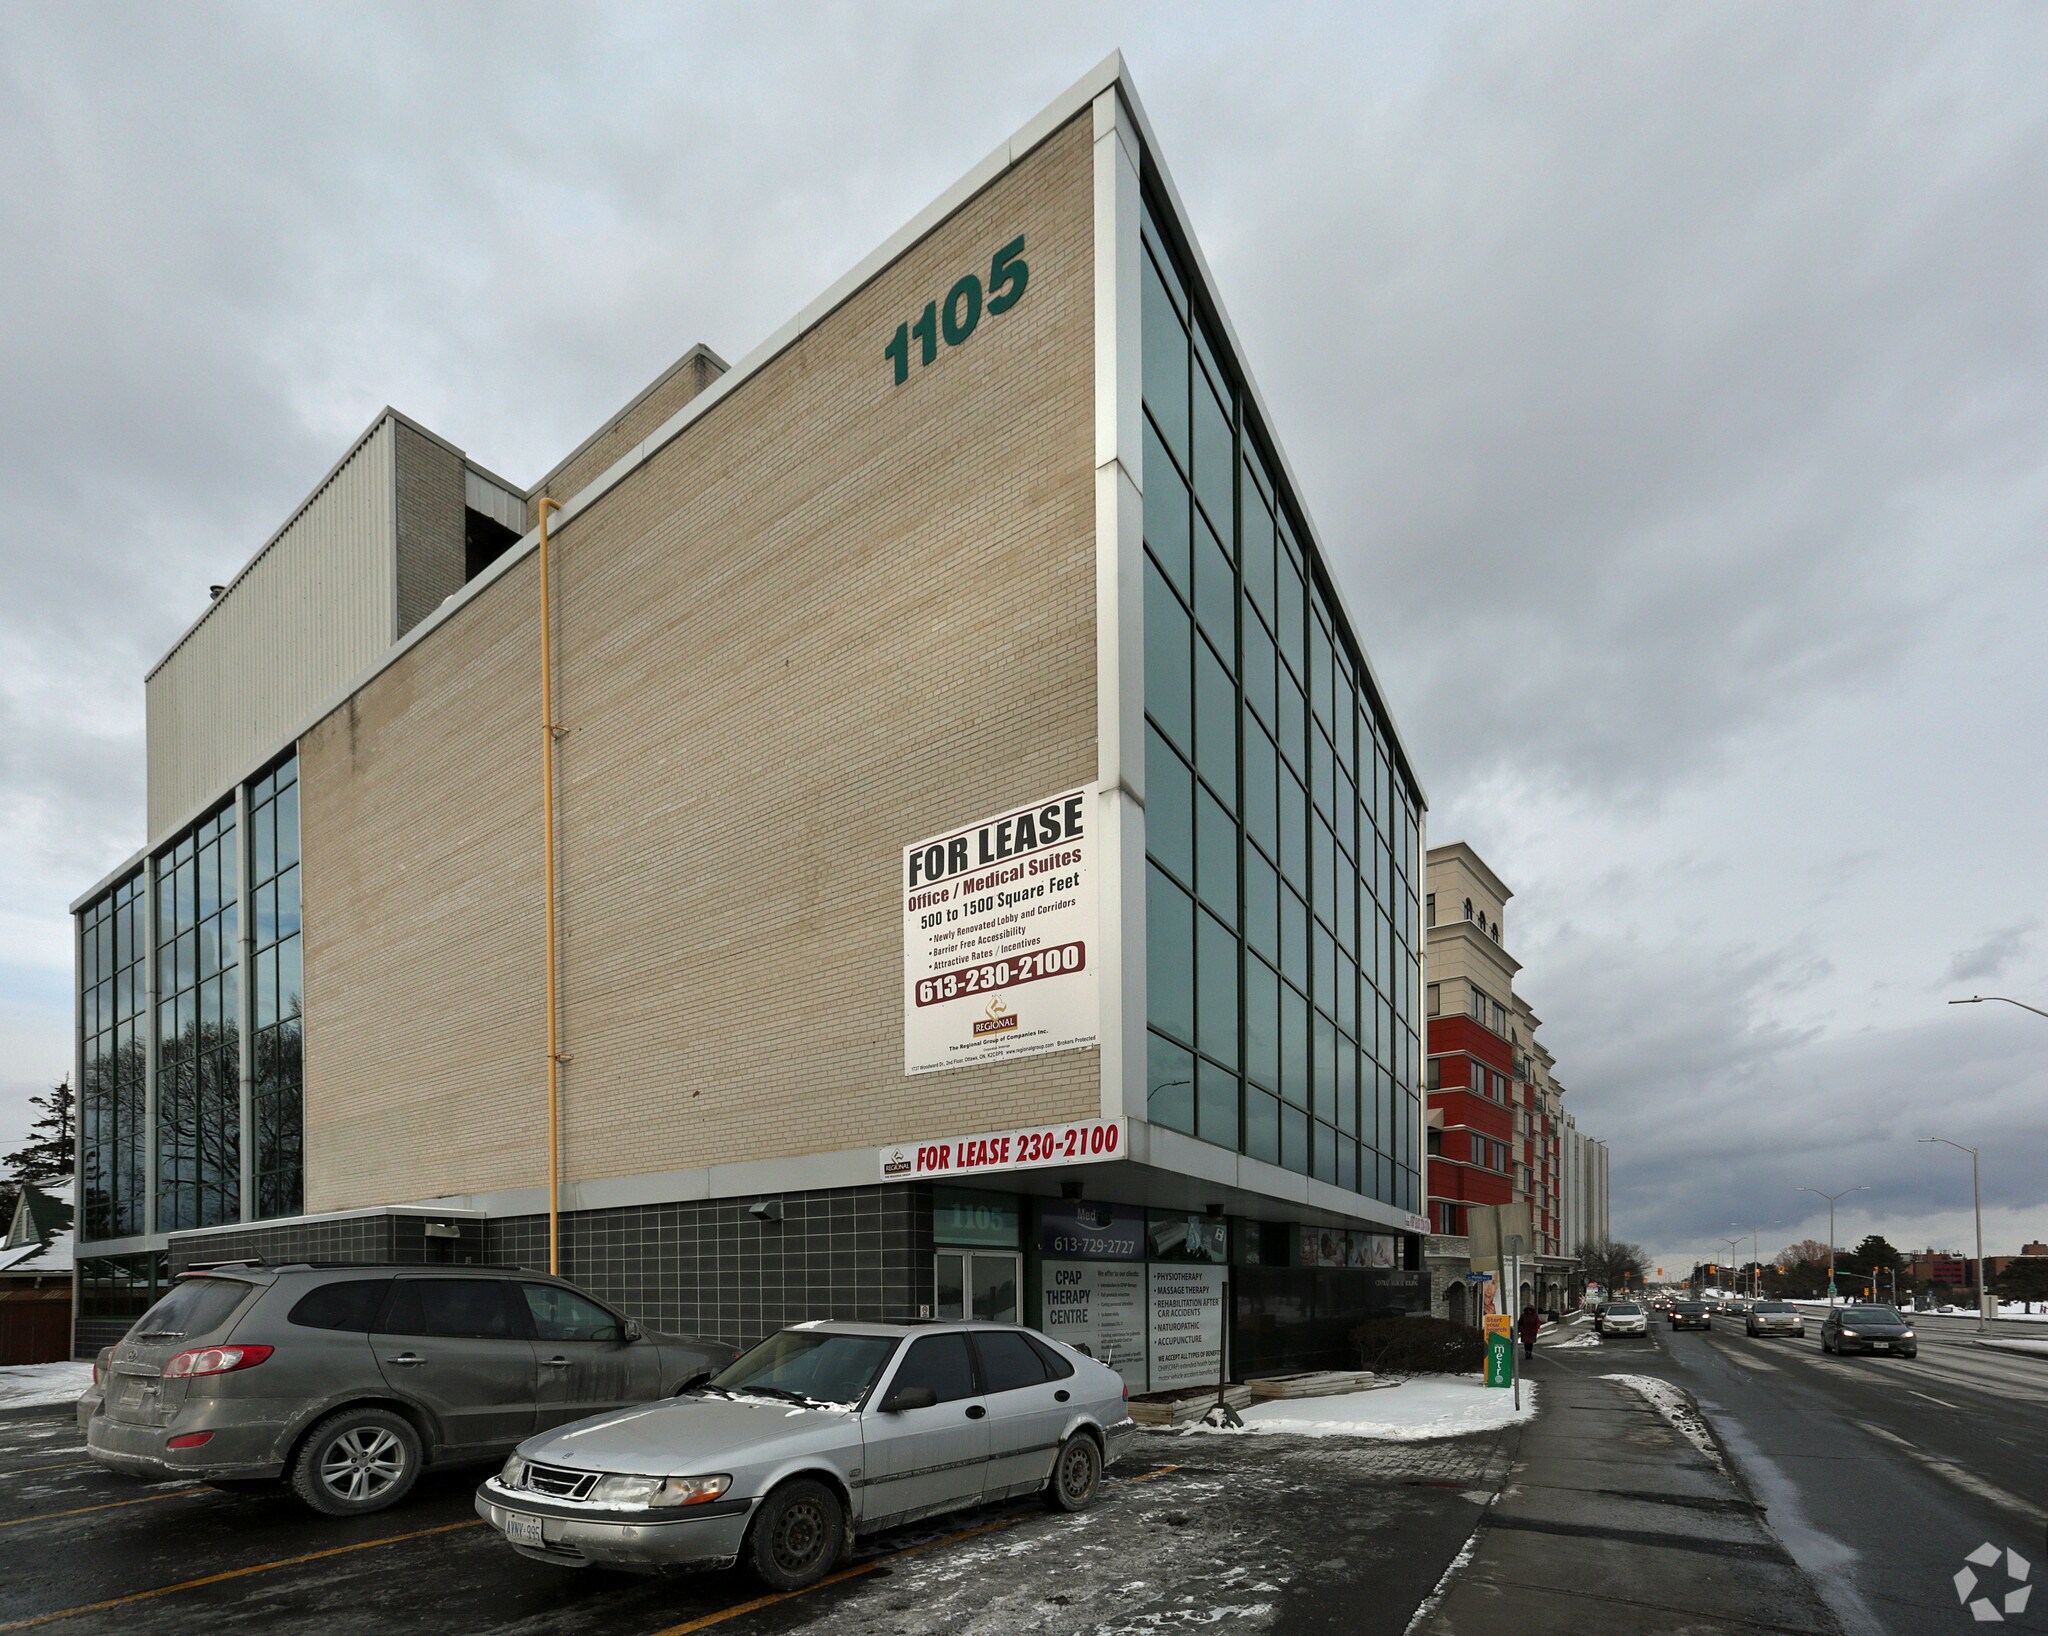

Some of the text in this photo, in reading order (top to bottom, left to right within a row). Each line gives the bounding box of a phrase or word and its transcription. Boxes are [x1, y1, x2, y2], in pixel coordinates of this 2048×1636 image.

[884, 233, 1029, 386] 1105
[909, 796, 1084, 888] FOR LEASE
[908, 848, 1082, 912] Office / Medical Suites
[921, 872, 1080, 930] 500 to 1500 Square Feet
[933, 898, 1076, 943] Newly Renovated Lobby and Corridors
[933, 925, 1027, 957] Barrier Free Accessibility
[934, 954, 970, 971] Attractive
[971, 948, 993, 961] Rates
[1001, 936, 1041, 954] Incentives
[919, 945, 1079, 1003] 613-230-2100
[975, 1016, 1015, 1033] REGIONAL
[960, 1039, 982, 1050] Regional
[983, 1036, 999, 1045] Group
[1007, 1031, 1037, 1041] Companies
[917, 1124, 1118, 1172] FOR LEASE 230-2100
[951, 1204, 1004, 1231] 1105
[1054, 1236, 1135, 1255] 613-729-2727
[1056, 1270, 1082, 1285] CPAP
[1157, 1272, 1203, 1281] PHYSIOTHERAPY
[1046, 1289, 1091, 1305] THERAPY
[1157, 1285, 1210, 1295] MASSAGE THERAPY
[1157, 1298, 1219, 1308] REHABILITATION AFTER
[1050, 1309, 1088, 1325] CENTRE
[1157, 1308, 1201, 1318] CAR ACCIDENTS
[1157, 1321, 1200, 1332] NATUROPATHIC
[1157, 1334, 1202, 1346] ACCUPUNCTURE
